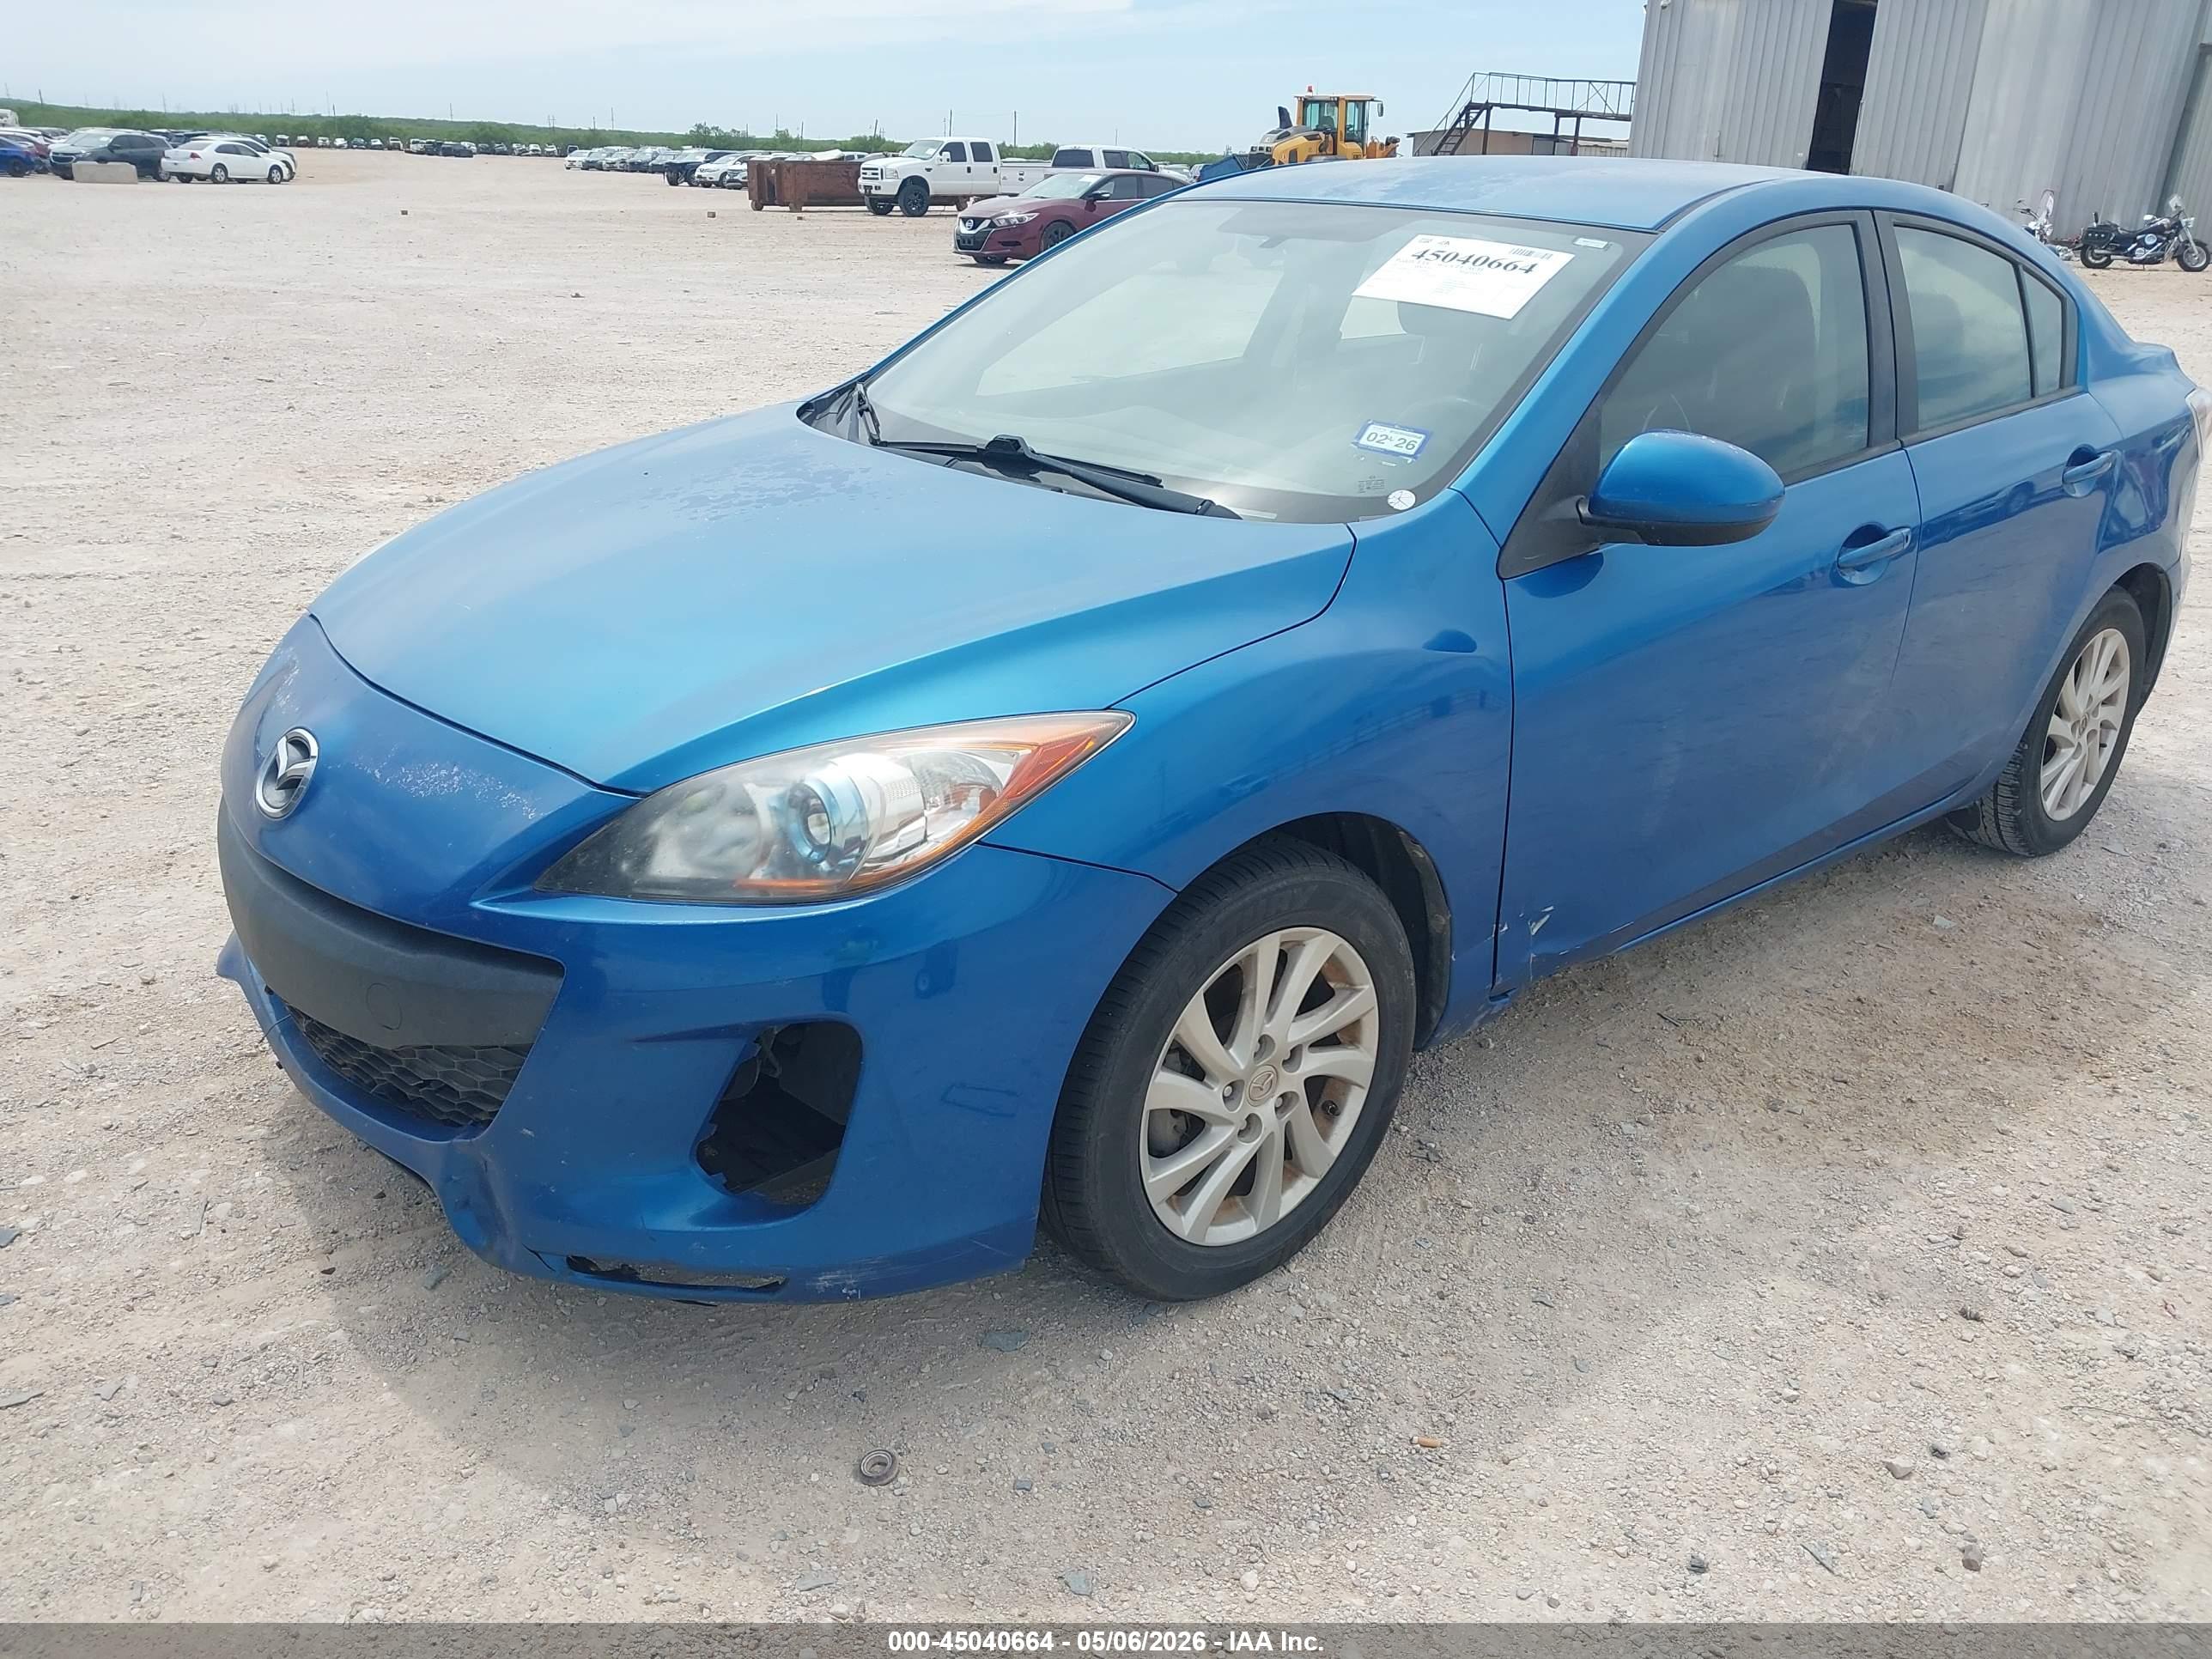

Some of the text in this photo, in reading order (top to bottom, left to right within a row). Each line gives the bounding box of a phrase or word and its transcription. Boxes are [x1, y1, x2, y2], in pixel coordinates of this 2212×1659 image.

[1412, 248, 1539, 274] 45040664
[1366, 432, 1389, 445] 02
[1394, 438, 1418, 451] 26
